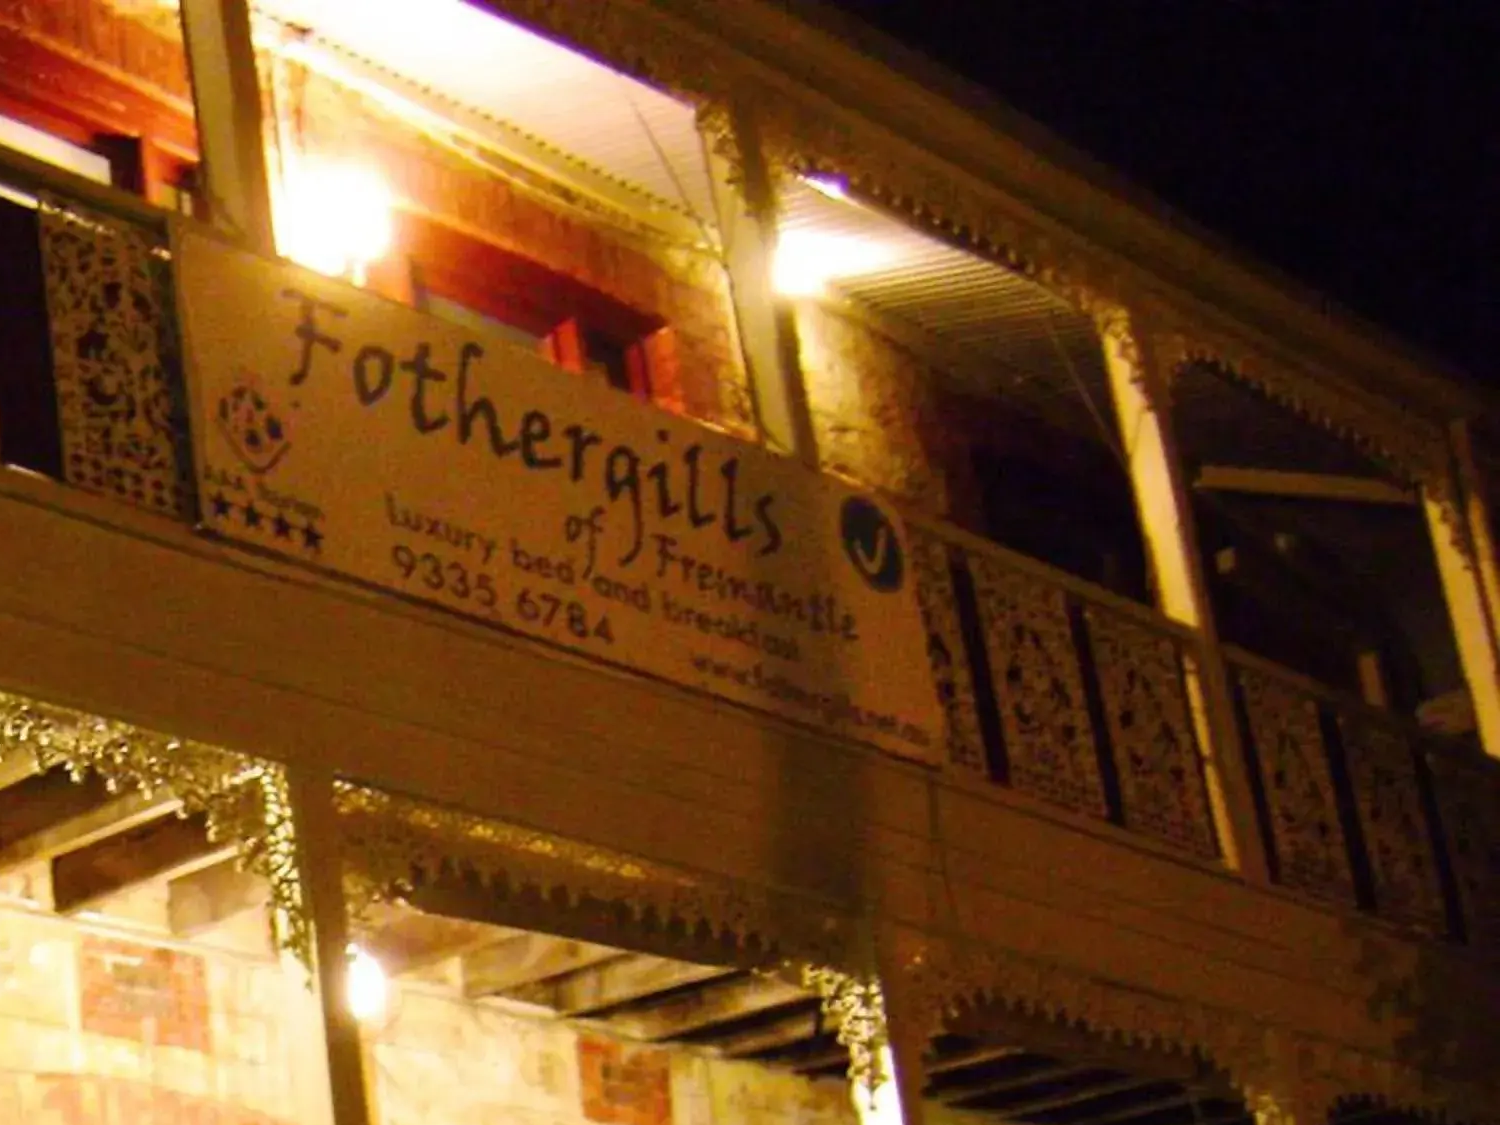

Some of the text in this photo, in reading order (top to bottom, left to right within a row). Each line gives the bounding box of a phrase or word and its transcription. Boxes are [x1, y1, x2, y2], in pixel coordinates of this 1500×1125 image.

[283, 288, 783, 567] Fothergills
[510, 538, 575, 586] bed
[590, 576, 651, 615] and
[565, 505, 607, 581] of
[392, 545, 615, 645] 9335 6784
